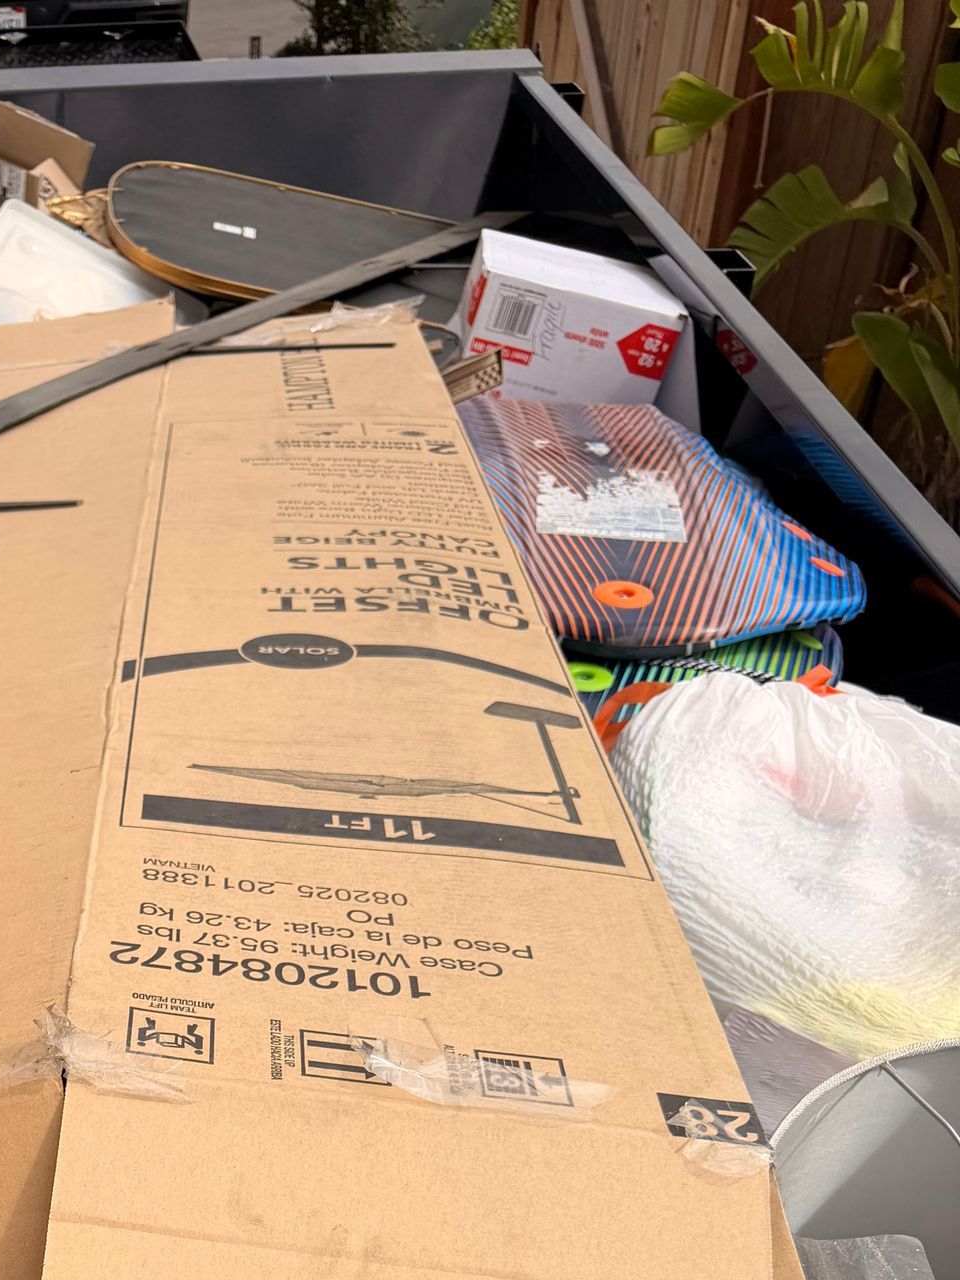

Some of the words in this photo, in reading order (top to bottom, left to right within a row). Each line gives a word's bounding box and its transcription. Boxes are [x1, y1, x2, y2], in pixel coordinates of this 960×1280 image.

[427, 443, 458, 455] 2
[272, 536, 375, 545] BEIGE
[344, 529, 494, 547] CANOPY
[391, 539, 499, 558] PUTTY
[287, 556, 512, 586] LIGHTS
[398, 574, 519, 604] LED
[355, 587, 524, 615] UMBRELLA
[268, 596, 529, 631] OFFSET
[258, 646, 340, 656] SOLAR
[324, 814, 371, 830] FT
[382, 818, 436, 841] 11
[143, 858, 216, 873] VIETNAM
[139, 902, 174, 921] kg
[346, 910, 394, 927] PO
[186, 910, 271, 932] 43.26
[284, 921, 354, 939] caja:
[136, 924, 181, 942] lbs
[364, 930, 391, 945] la
[402, 934, 442, 949] de
[193, 932, 279, 954] 95.37
[453, 939, 533, 959] Peso
[291, 943, 409, 968] Weight:
[110, 940, 432, 999] 1012084872
[420, 956, 503, 977] Case
[132, 992, 168, 1003] PESADO
[148, 1002, 168, 1010] LIFT
[170, 1004, 197, 1014] TEAM
[270, 1020, 281, 1031] ESTE
[270, 1032, 281, 1045] LADO
[284, 1035, 294, 1046] THIS
[270, 1046, 281, 1060] HACIA
[284, 1047, 295, 1059] SIDE
[271, 1061, 283, 1080] ARRIBA
[681, 1104, 759, 1142] 28
